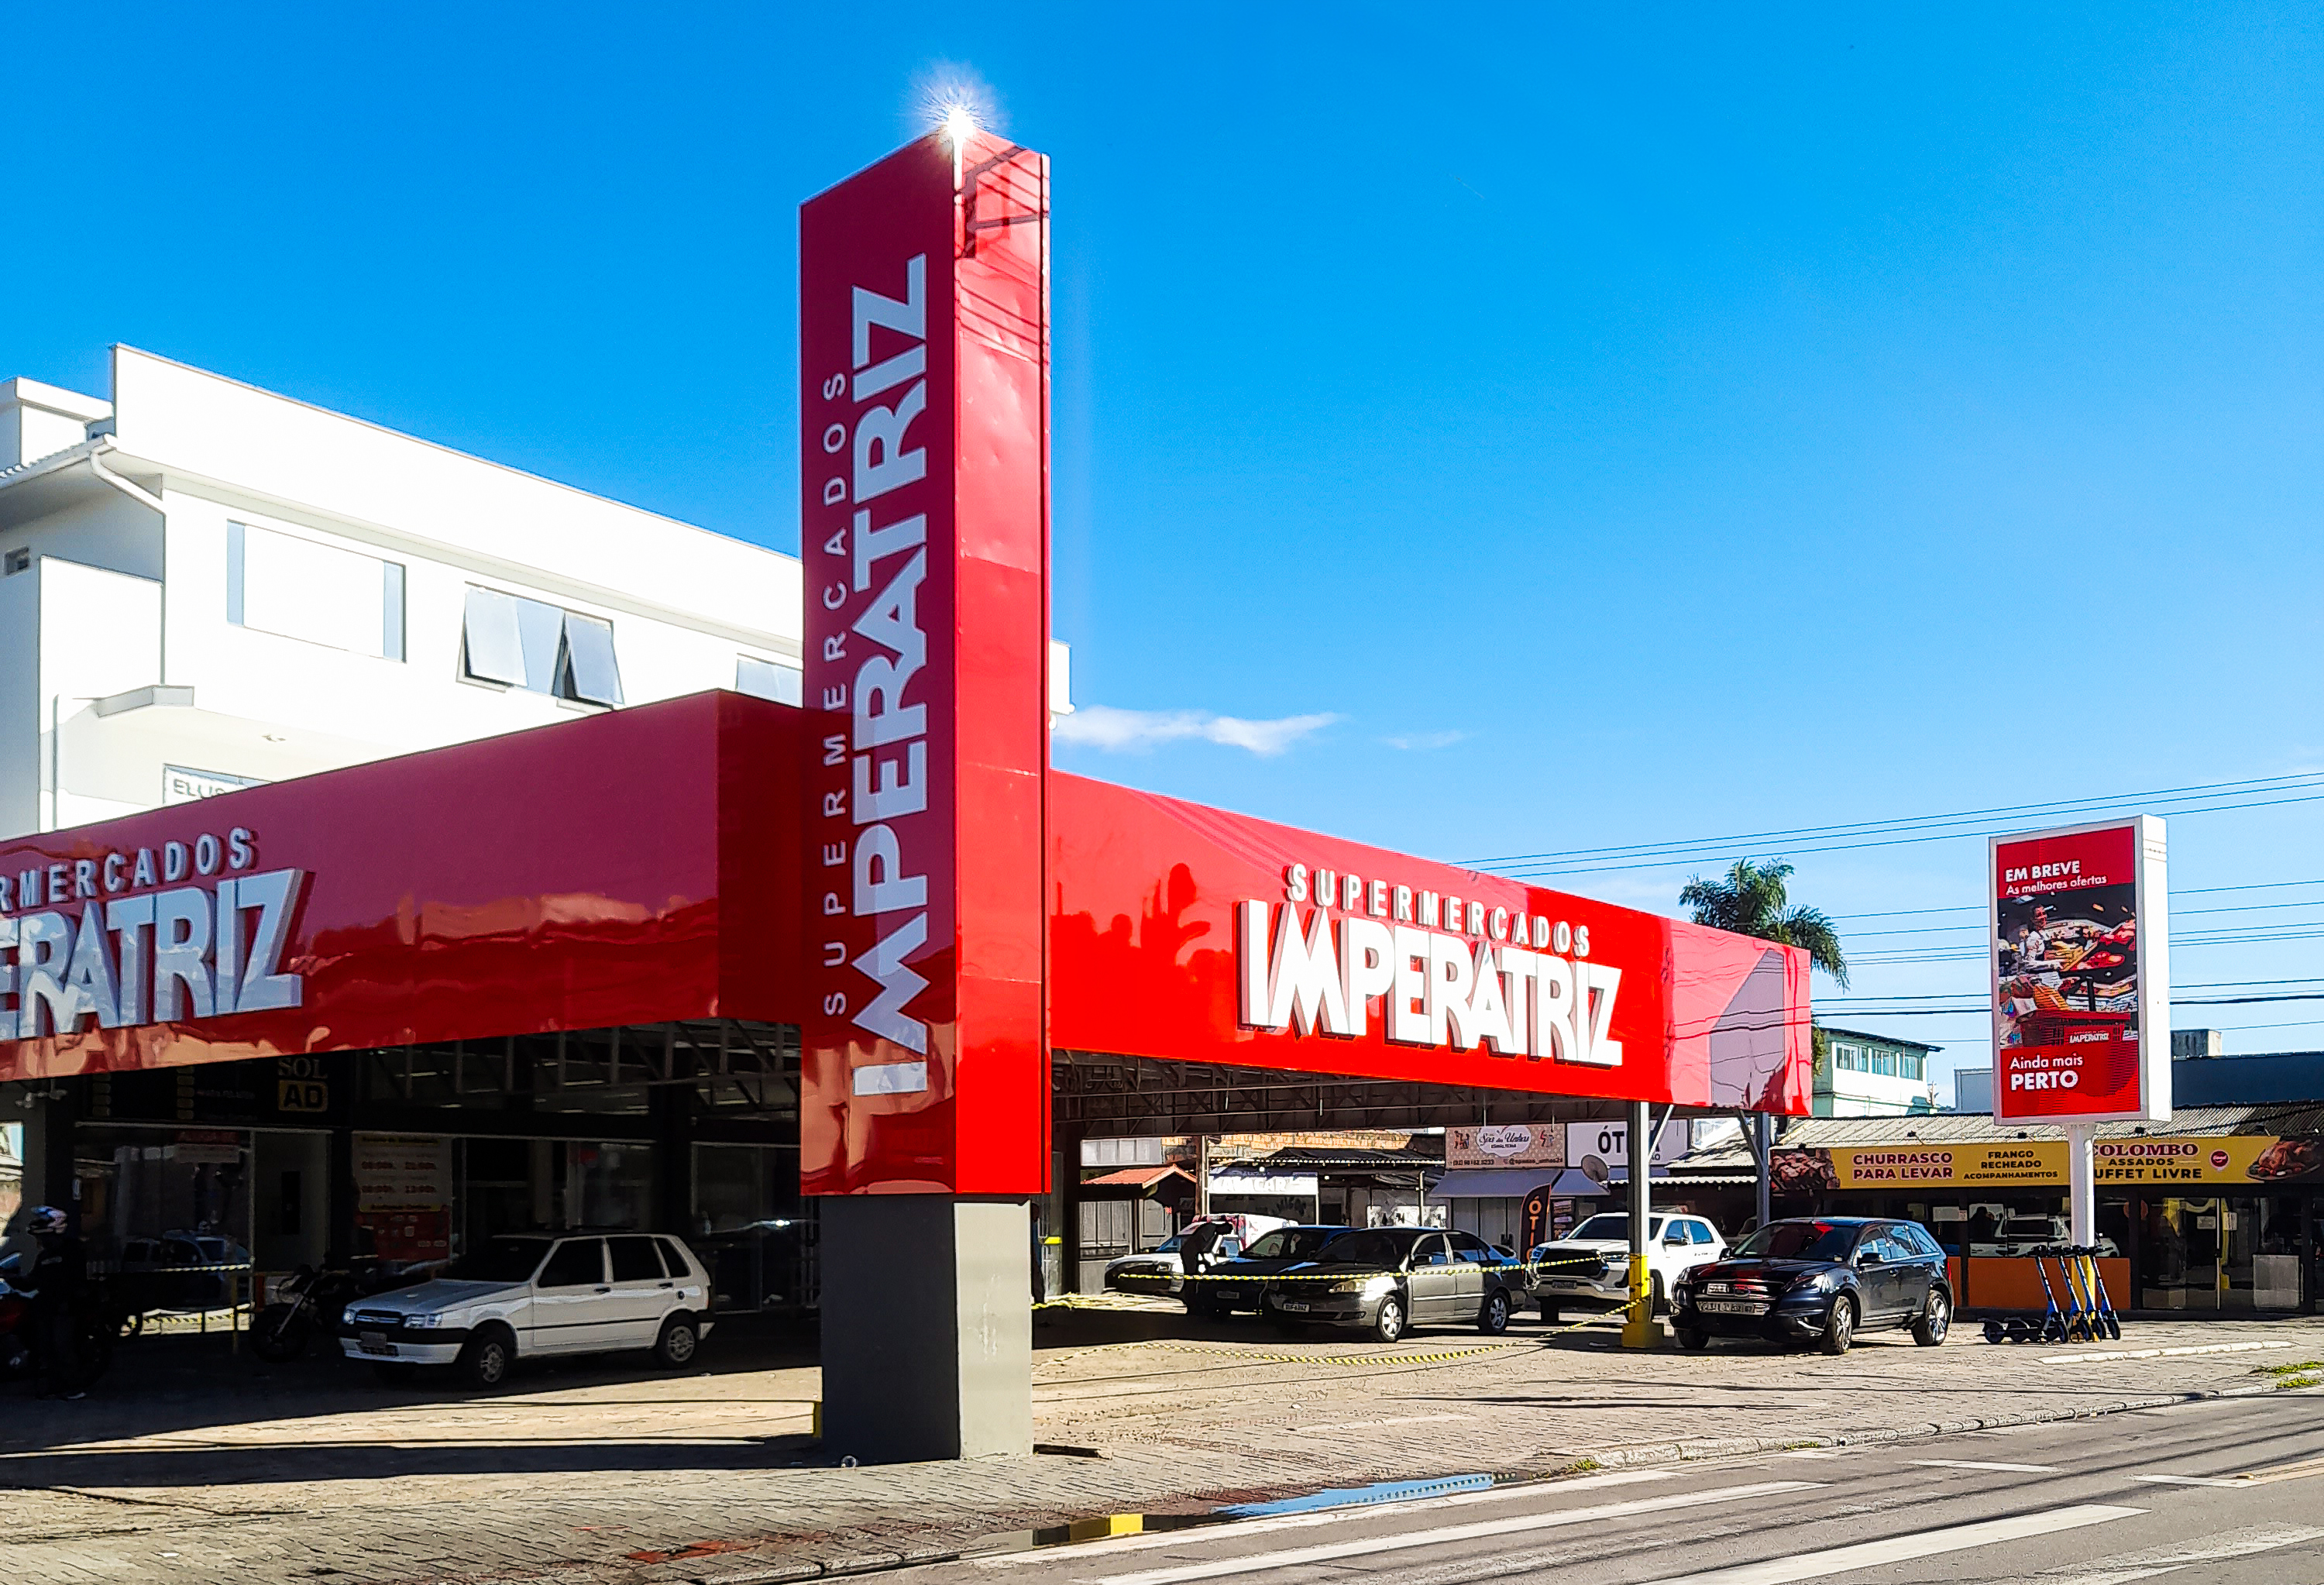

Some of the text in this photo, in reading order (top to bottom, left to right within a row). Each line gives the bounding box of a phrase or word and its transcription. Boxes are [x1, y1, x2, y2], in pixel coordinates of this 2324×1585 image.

[853, 253, 930, 1096] IMPERATRIZ
[823, 373, 846, 1015] SUPERMERCADOS
[2006, 860, 2080, 882] EM BREVE
[2006, 875, 2107, 895] As melhores ofertas
[1286, 863, 1590, 958] SUPERMERCADOS
[1239, 899, 1623, 1066] IMPERATRIZ
[2009, 1053, 2083, 1070] Ainda mais
[2011, 1070, 2078, 1090] PERTO
[1852, 1152, 1954, 1165] CHURRASCO
[1988, 1150, 2034, 1159] FRANGO
[1853, 1167, 1954, 1180] PARA LEVAR
[1981, 1160, 2042, 1169] RECHEADO
[2095, 1168, 2202, 1179] UFFET LIVRE
[1964, 1171, 2058, 1180] ACOMPANHAMENTOS
